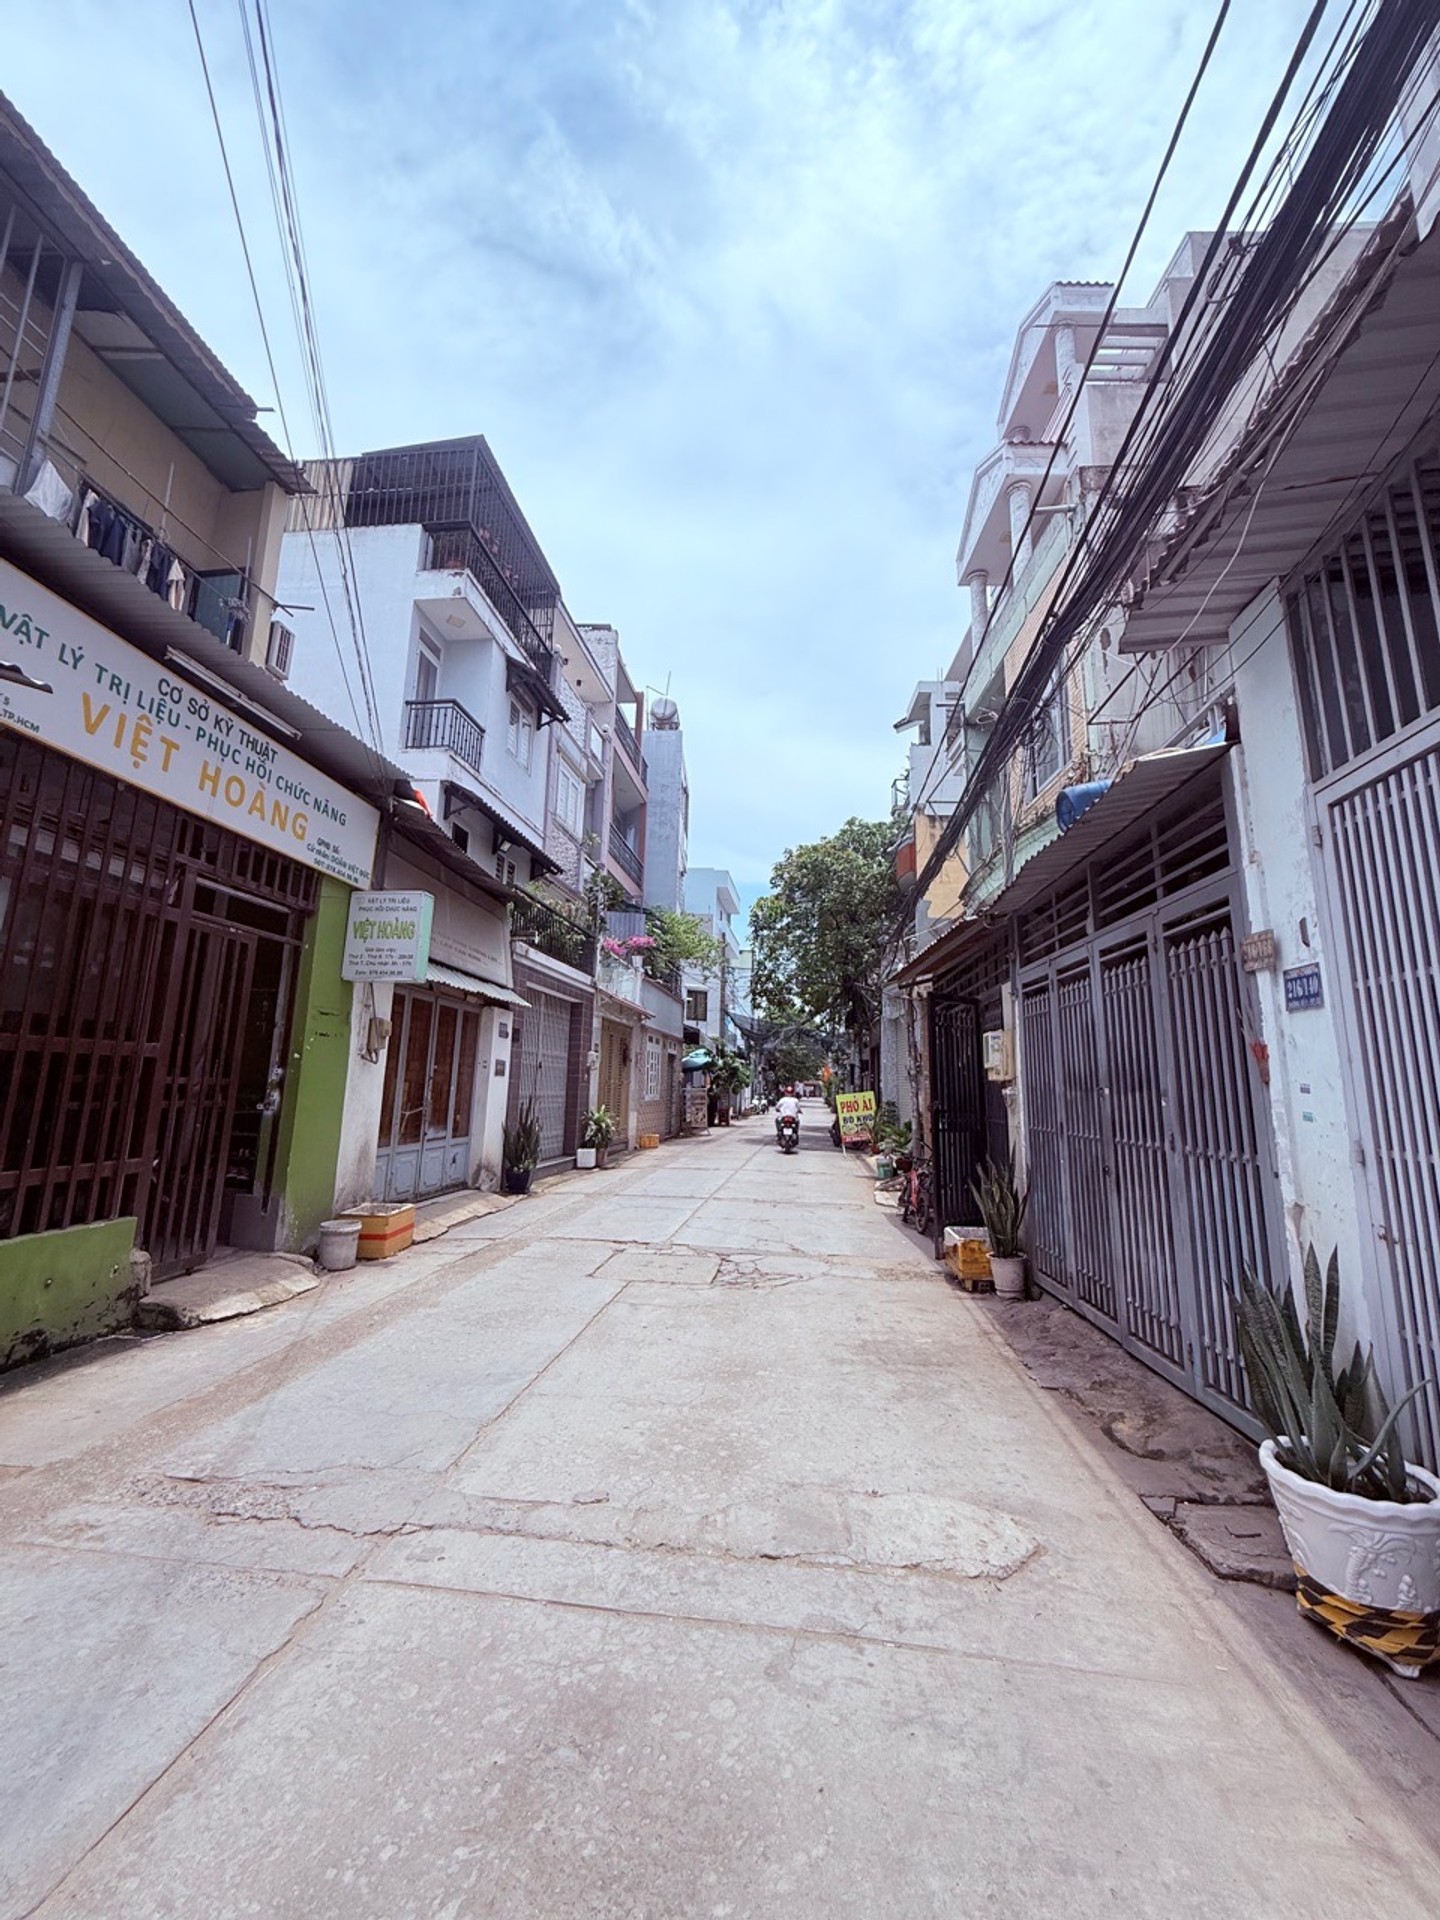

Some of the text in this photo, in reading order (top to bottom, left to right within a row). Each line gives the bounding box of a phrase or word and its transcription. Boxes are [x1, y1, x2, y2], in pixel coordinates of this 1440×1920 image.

[0, 604, 50, 649] VẬT
[58, 642, 85, 670] LÝ
[95, 663, 130, 705] TRỊ
[137, 690, 181, 728] LIỆU
[196, 726, 241, 765] PHỤC
[245, 756, 272, 783] HỒI
[275, 775, 311, 806] CHỨC
[313, 798, 347, 826] NĂNG
[82, 691, 309, 841] VIỆT HOÀNG
[158, 678, 184, 705] CƠ
[187, 698, 210, 721] SỞ
[239, 729, 278, 764] THUẬT
[353, 917, 416, 943] VIỆT HOÀNG
